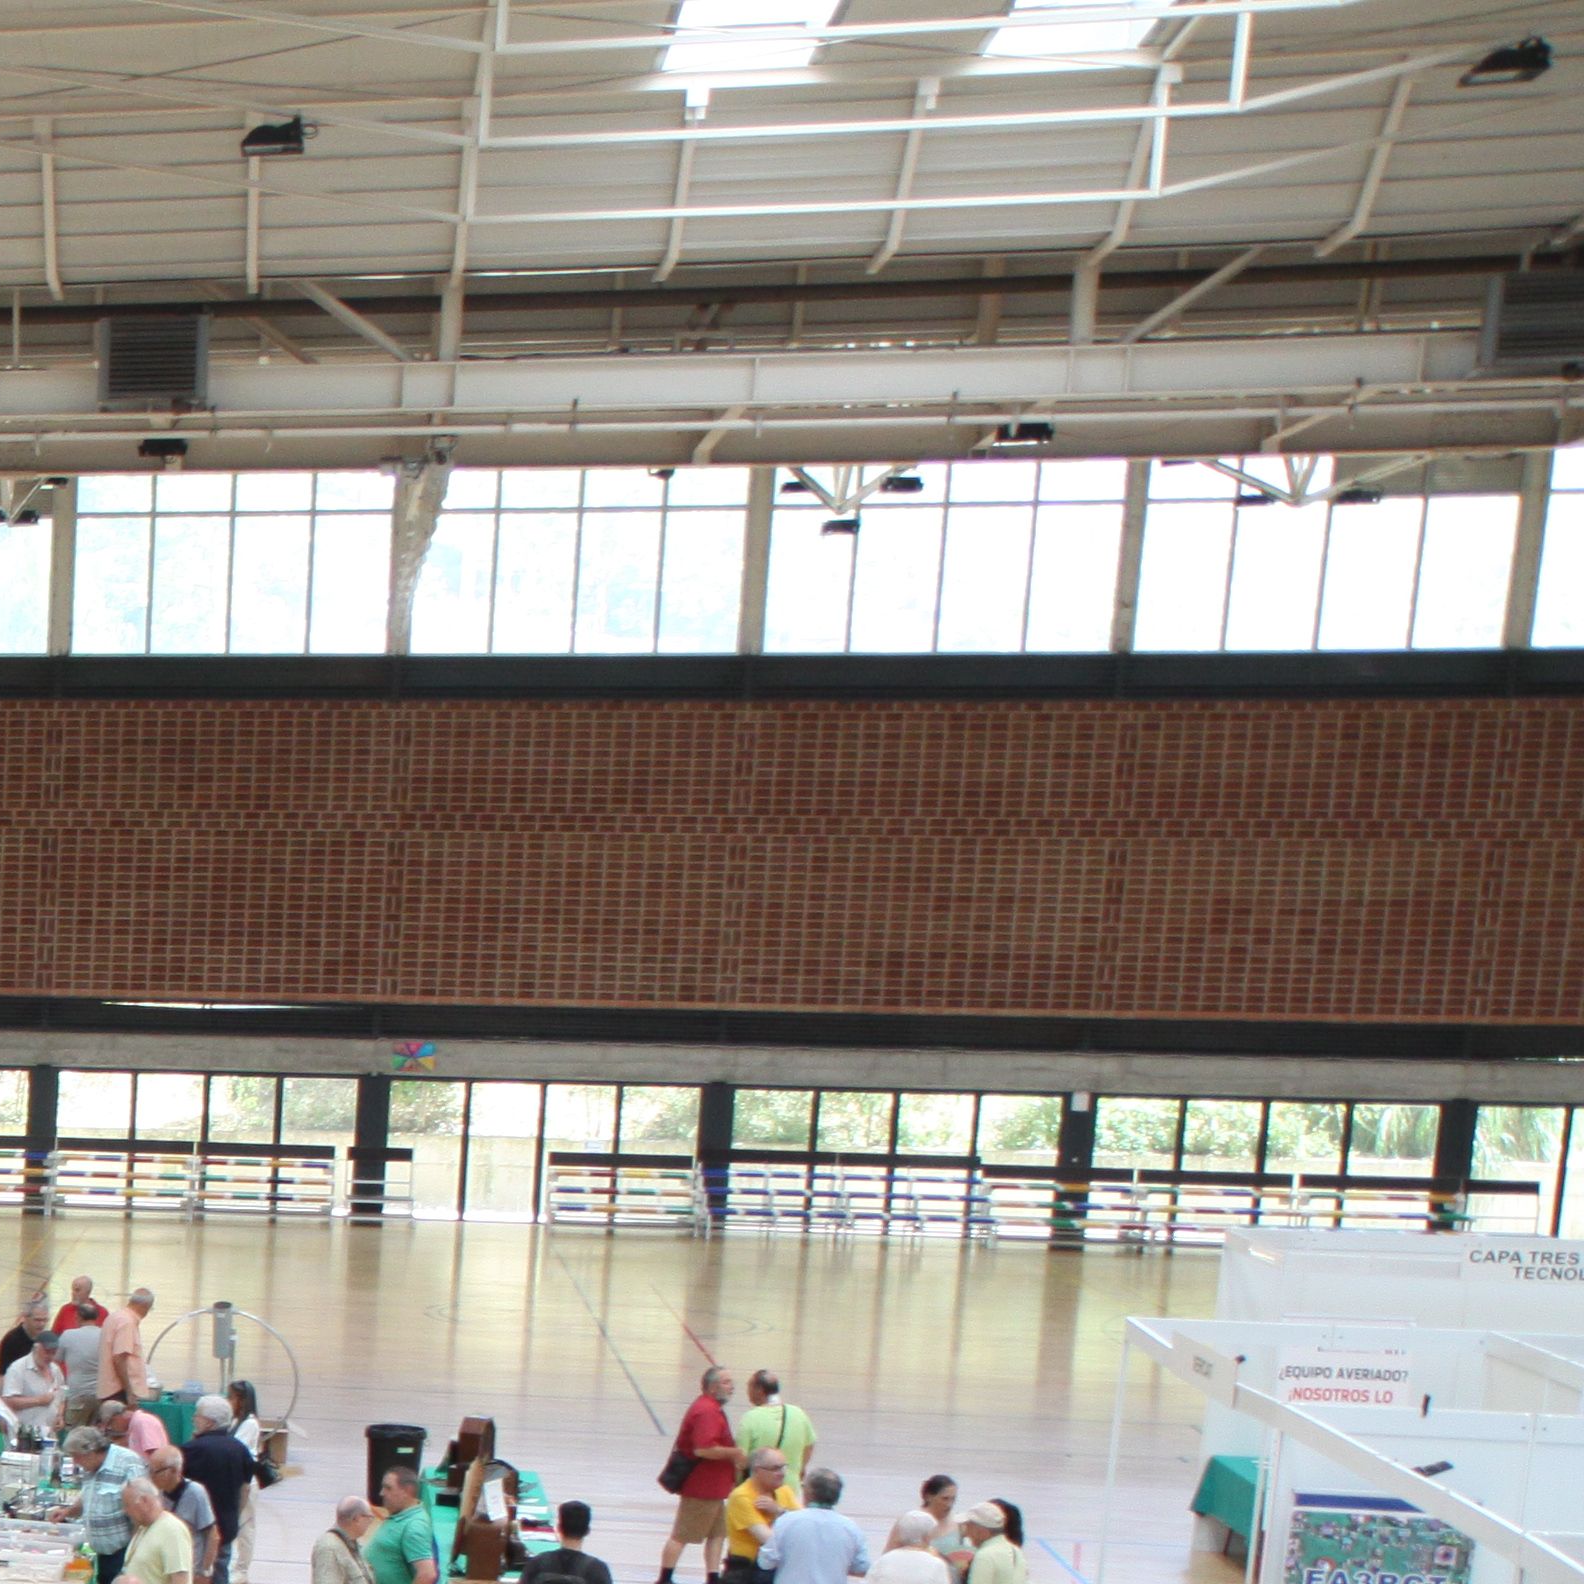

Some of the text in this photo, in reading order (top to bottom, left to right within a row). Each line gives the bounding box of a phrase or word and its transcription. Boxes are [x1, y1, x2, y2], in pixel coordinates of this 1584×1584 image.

[1468, 1249, 1581, 1266] CAPA TRES
[1278, 1365, 1409, 1383] ¿EQUIPO AVERIADO?
[1287, 1387, 1393, 1404] ¡NOSOTROS LO
